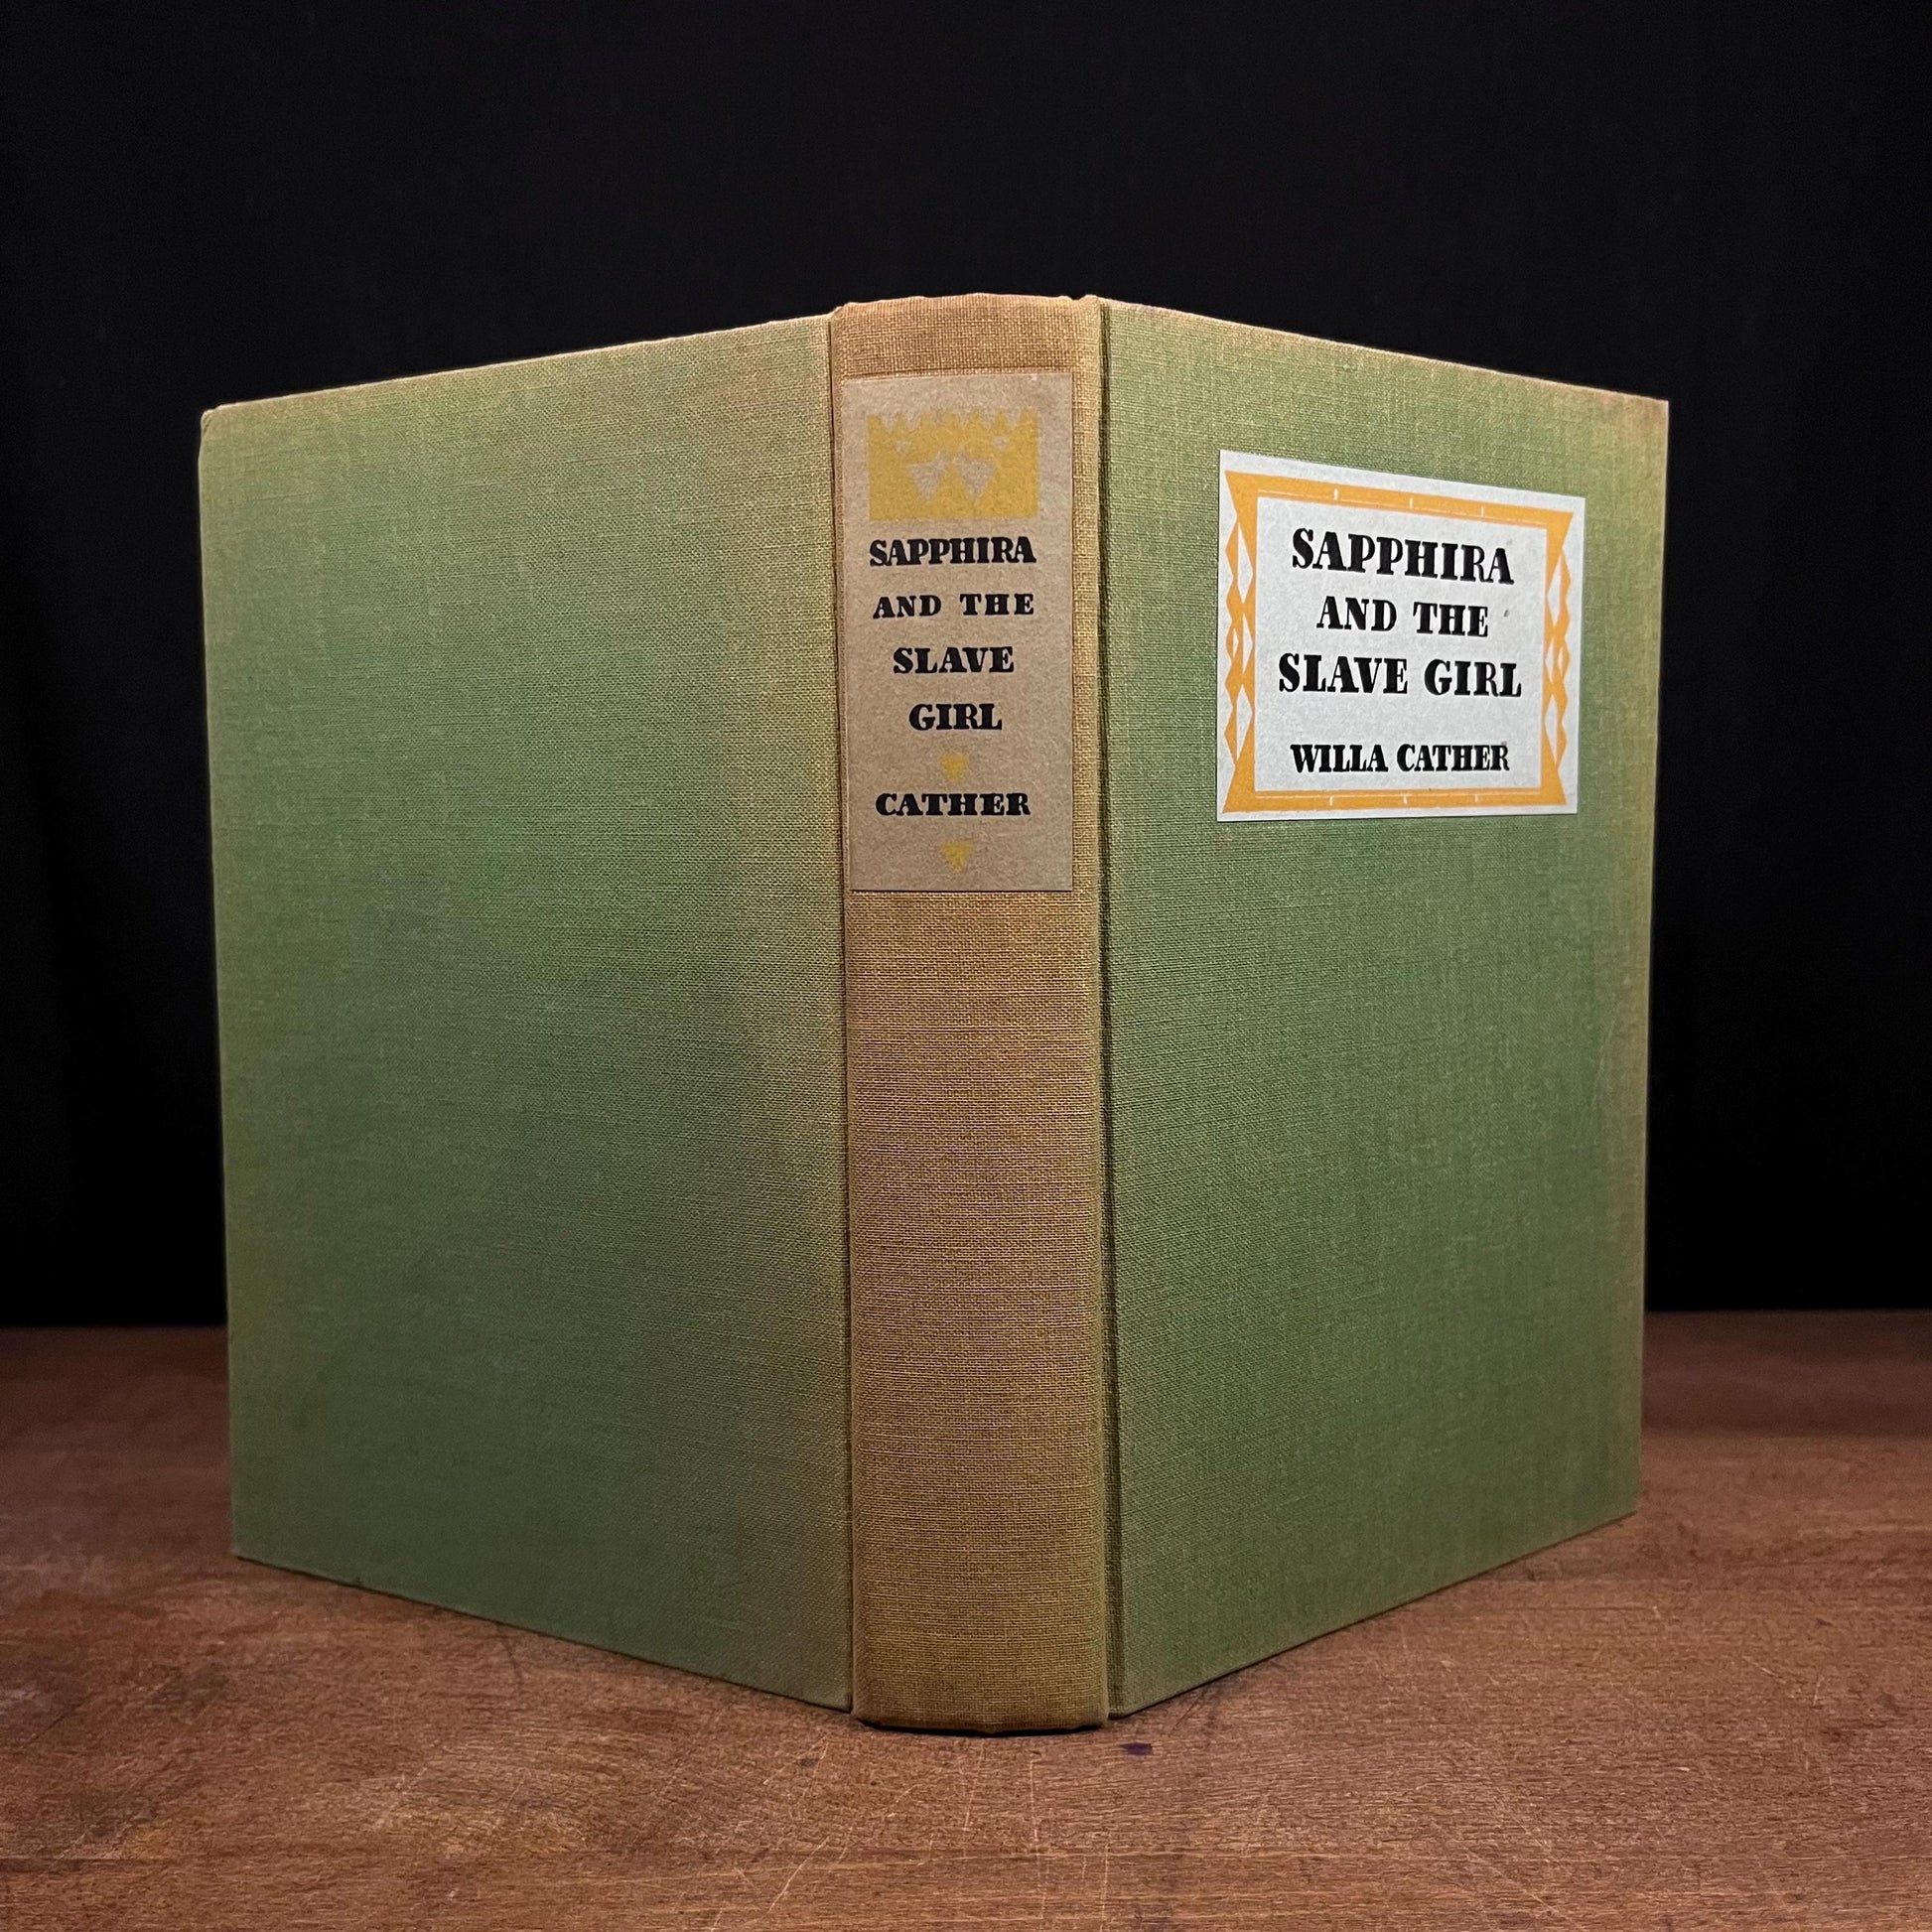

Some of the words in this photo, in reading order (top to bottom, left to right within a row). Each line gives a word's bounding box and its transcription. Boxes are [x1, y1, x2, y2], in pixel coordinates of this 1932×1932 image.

[869, 534, 1037, 567] SAPPHIRA
[1292, 527, 1515, 585] SAPPHIRA
[872, 594, 942, 620] AND
[959, 593, 1035, 617] THE
[1315, 595, 1397, 631] AND
[1413, 601, 1488, 637] THE
[893, 645, 1015, 674] SLAVE
[1279, 652, 1408, 694] SLAVE
[1424, 658, 1522, 698] GIRL
[908, 703, 1003, 732] GIRL
[1290, 744, 1389, 774] WILLA
[1396, 744, 1510, 773] CATHER
[875, 792, 1032, 817] CATHER
